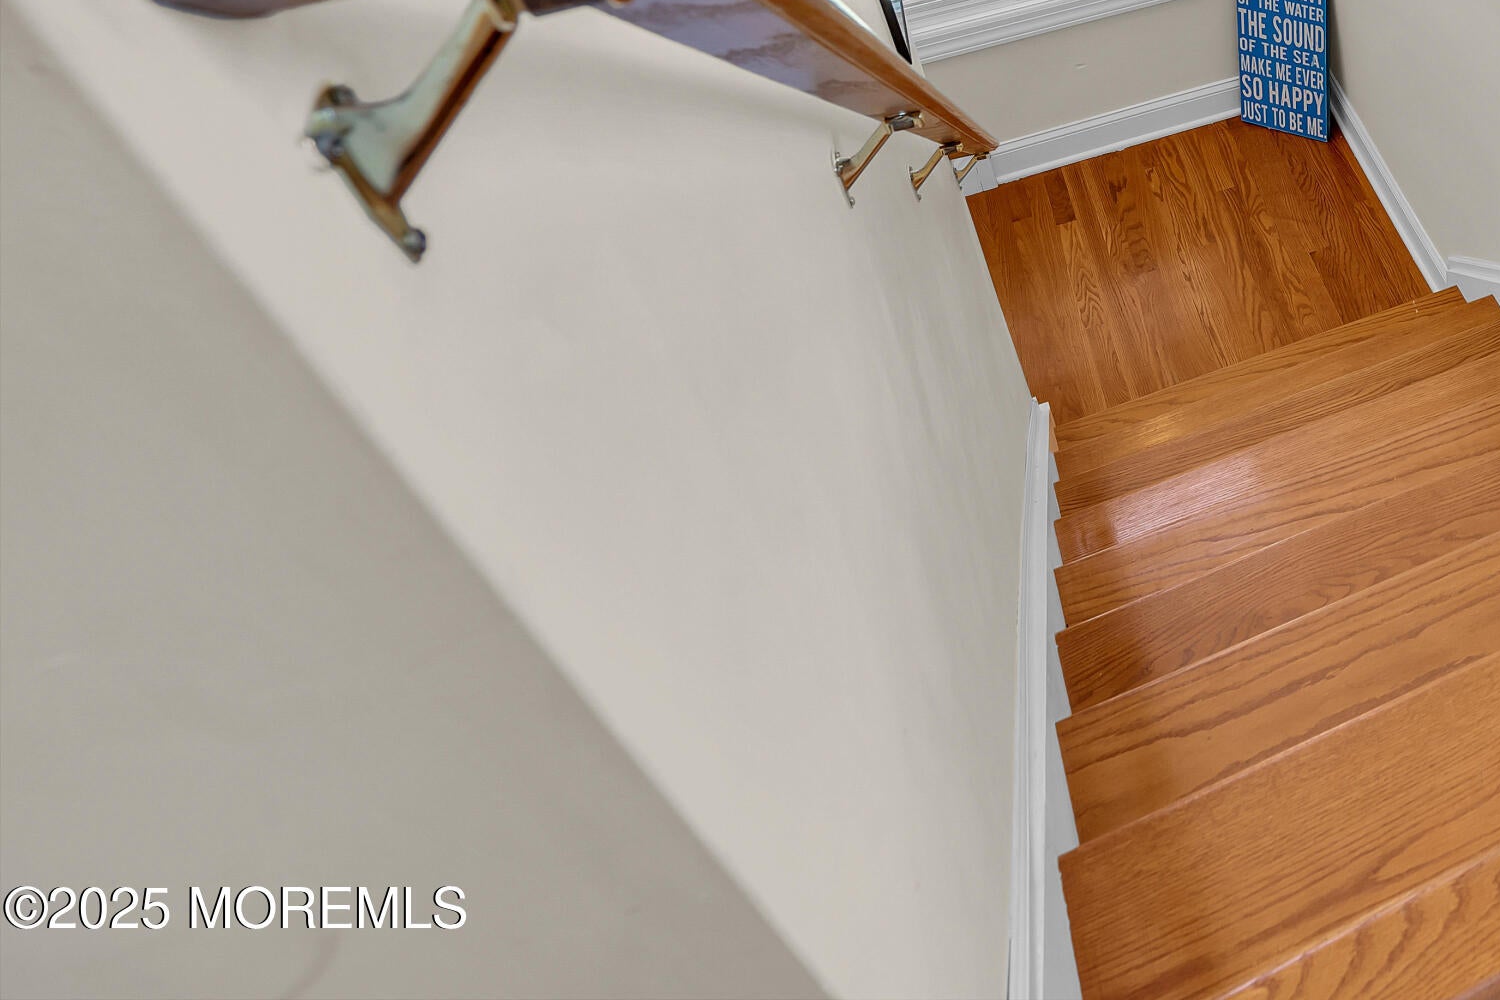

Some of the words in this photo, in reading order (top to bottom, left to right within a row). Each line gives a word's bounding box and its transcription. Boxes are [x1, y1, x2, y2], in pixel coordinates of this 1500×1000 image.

[1284, 0, 1324, 23] WATER
[1238, 7, 1266, 40] THE
[1273, 15, 1324, 53] SOUND
[1239, 37, 1255, 51] OF
[1261, 41, 1287, 60] THE
[1241, 53, 1271, 78] MAKE
[1276, 62, 1291, 82] ME
[1296, 67, 1324, 90] EVER
[1241, 75, 1263, 100] SO
[1269, 81, 1324, 115] HAPPY
[1243, 100, 1268, 124] JUST
[1272, 107, 1285, 129] TO
[1289, 112, 1303, 133] BE
